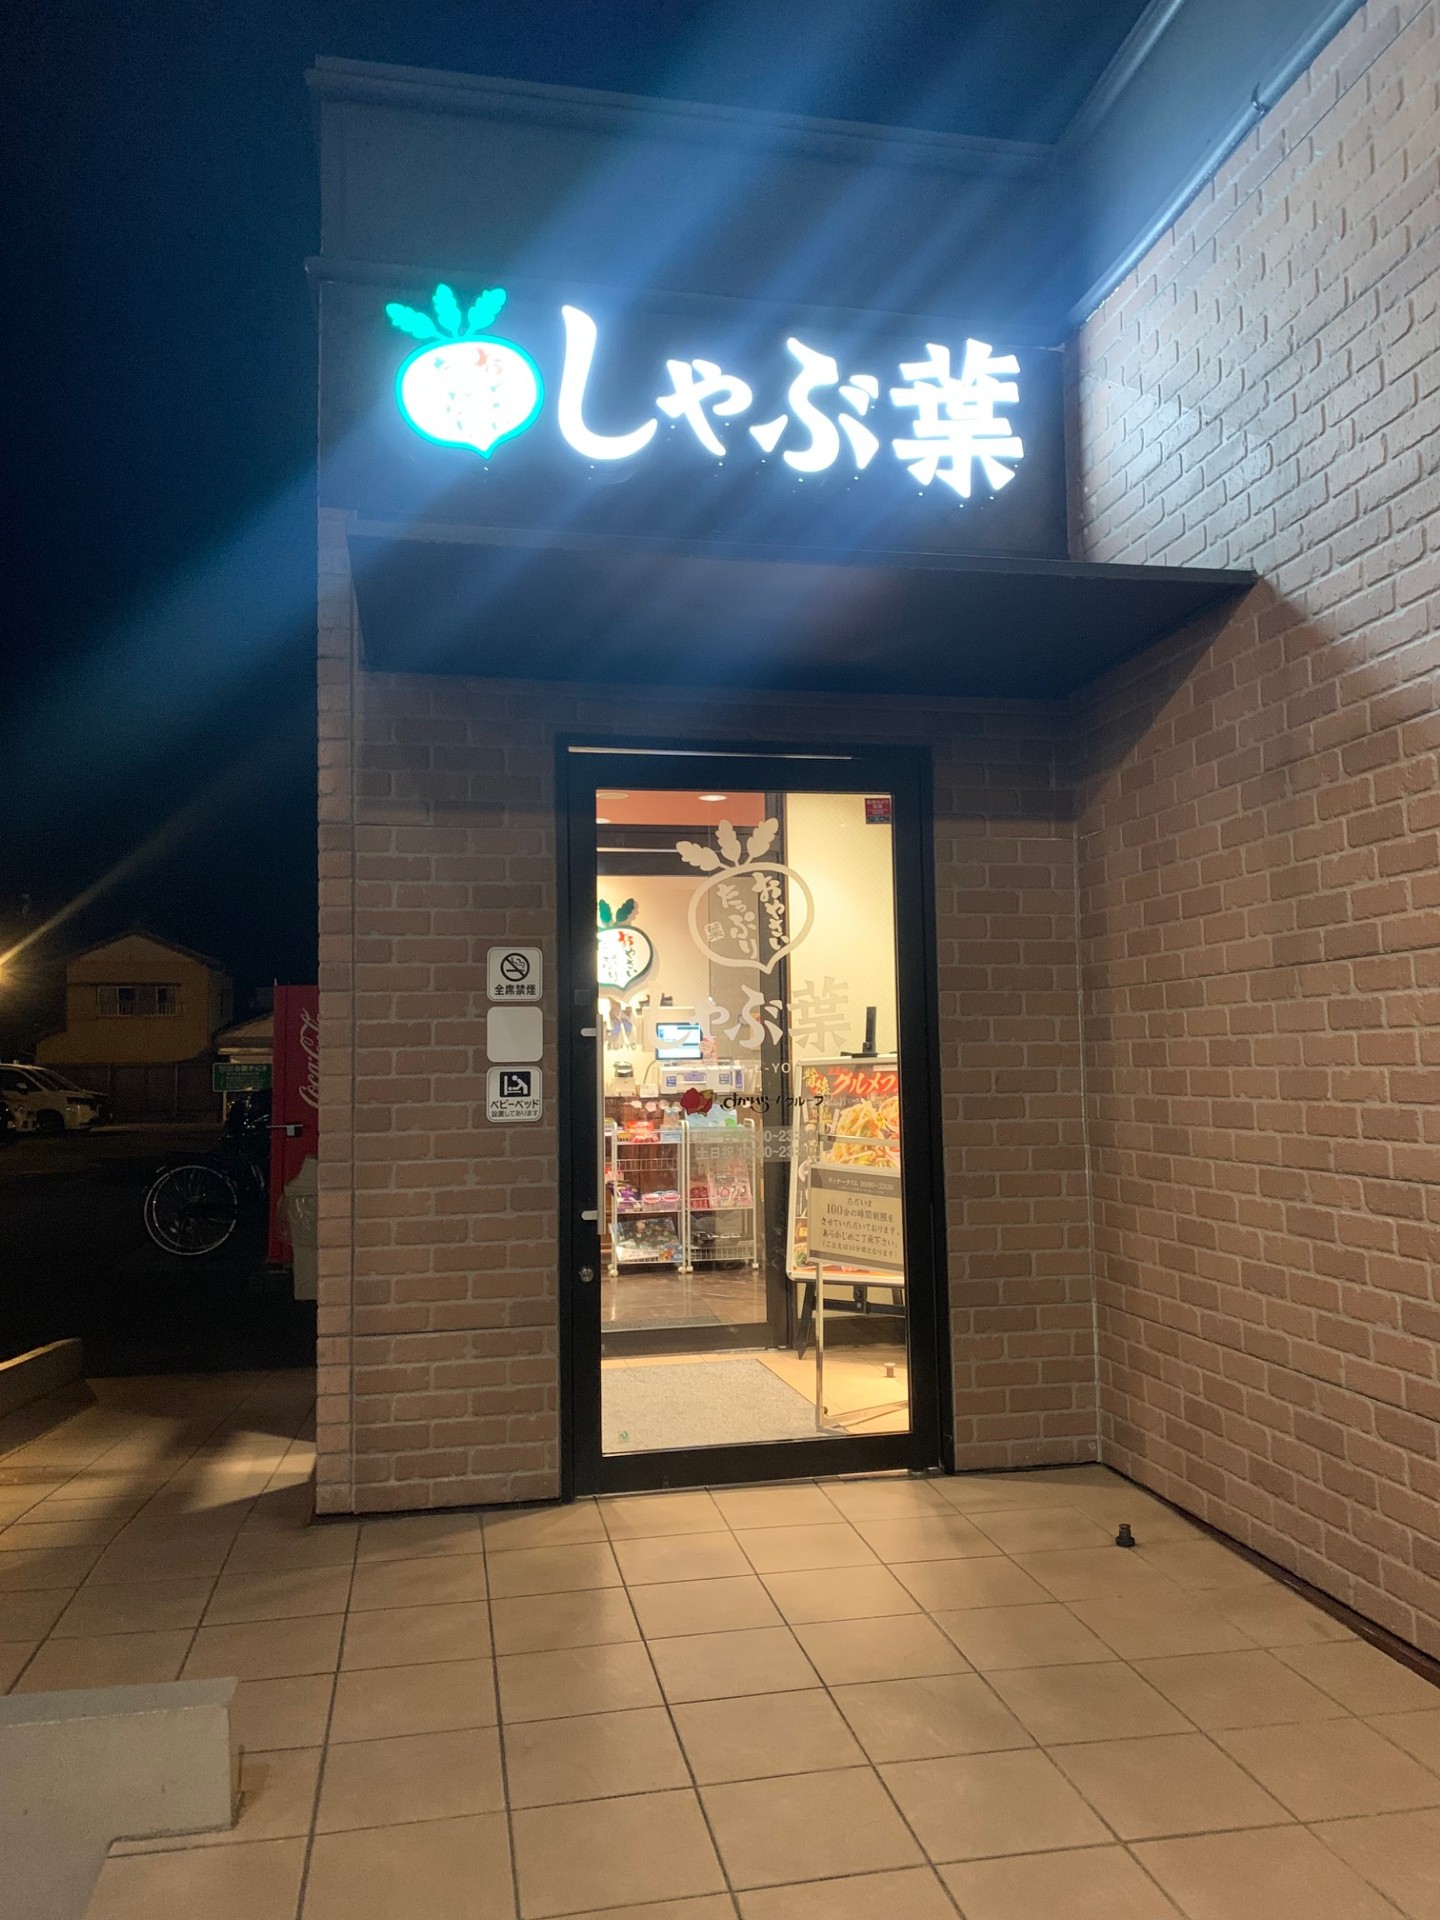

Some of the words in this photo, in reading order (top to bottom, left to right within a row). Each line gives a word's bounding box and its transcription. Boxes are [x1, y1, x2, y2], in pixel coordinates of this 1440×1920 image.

[557, 304, 1024, 499] しゃぶ葉
[716, 883, 757, 960] たっぷり
[752, 871, 789, 950] おやさい
[494, 983, 537, 996] 全席禁煙
[648, 975, 851, 1053] しゃぶ葉
[490, 1098, 540, 1109] ベビーベッド
[831, 1072, 898, 1096] グルメフ
[846, 1197, 873, 1208] ただいま
